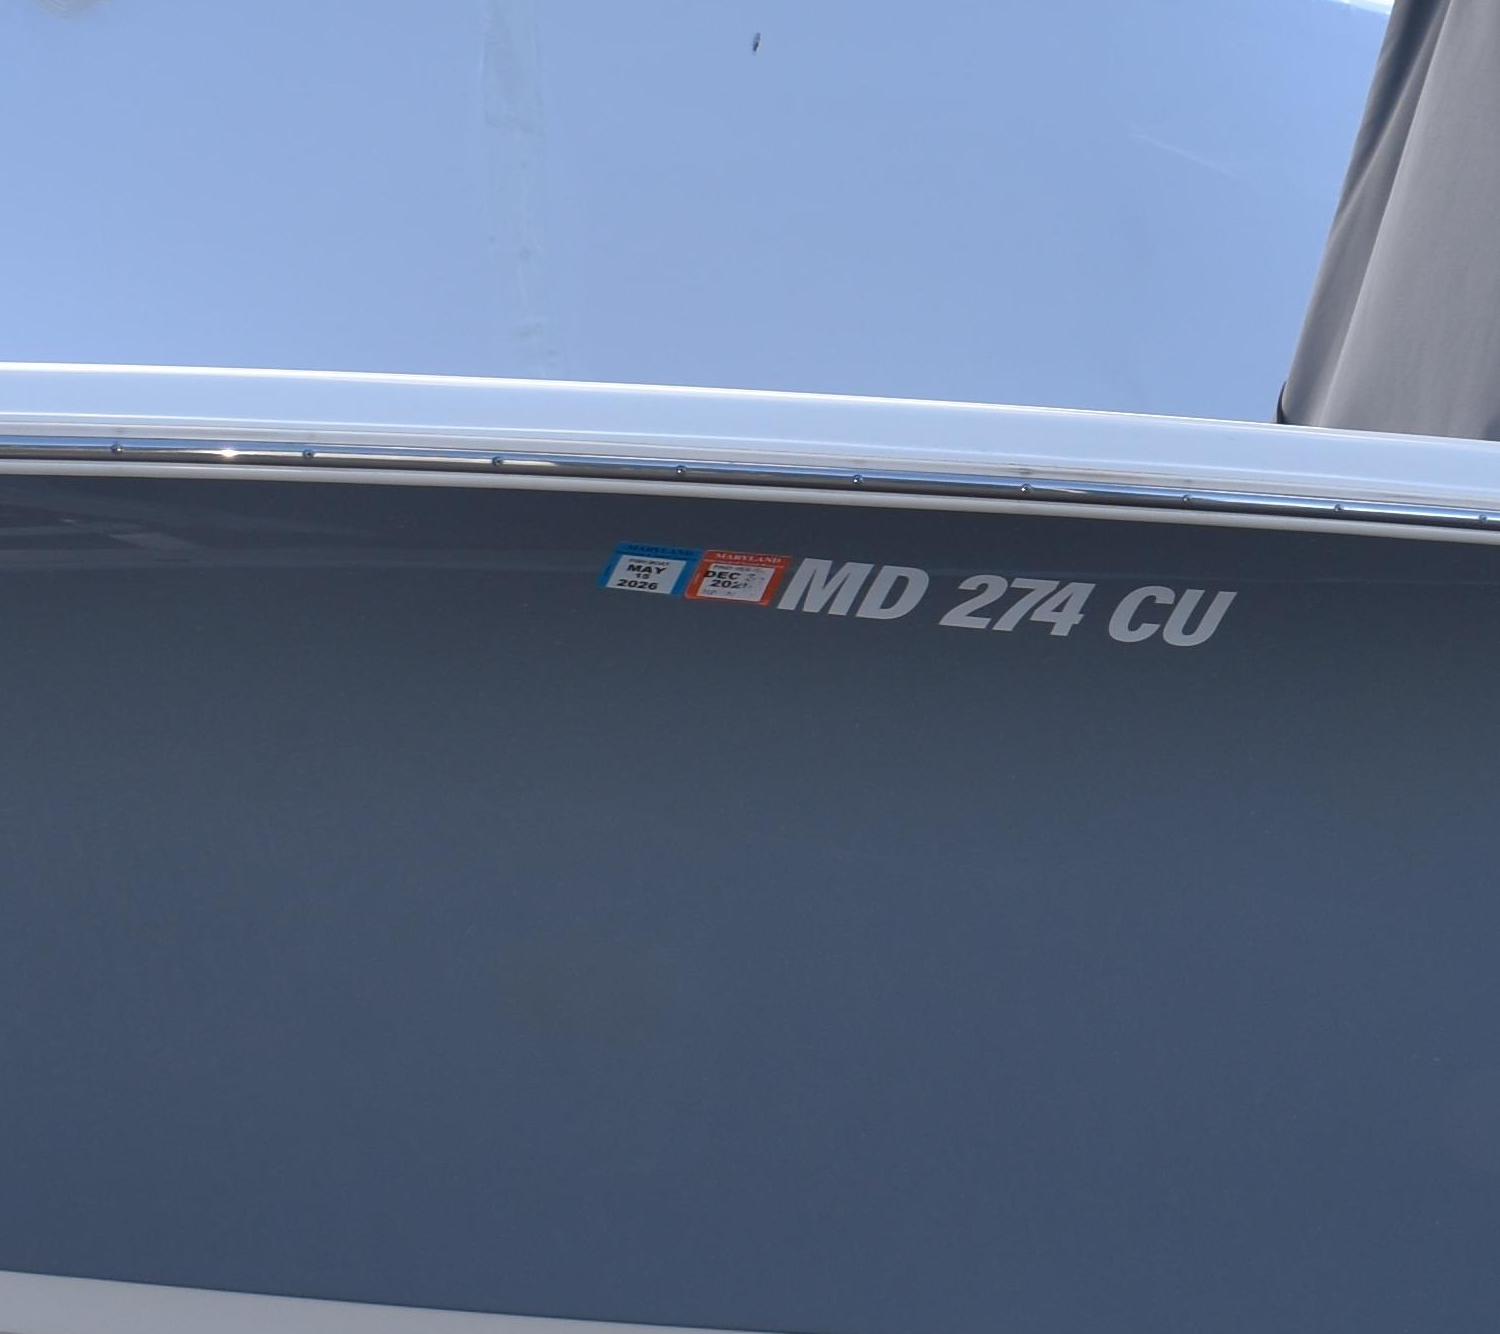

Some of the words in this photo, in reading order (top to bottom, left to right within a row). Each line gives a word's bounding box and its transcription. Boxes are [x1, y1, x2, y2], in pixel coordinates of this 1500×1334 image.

[714, 552, 783, 564] MARYLAND
[626, 564, 667, 575] MAY
[703, 570, 741, 581] DEC
[616, 578, 659, 591] 2026
[776, 557, 930, 621] MD
[938, 574, 1097, 637] 274
[1107, 584, 1238, 647] CU
